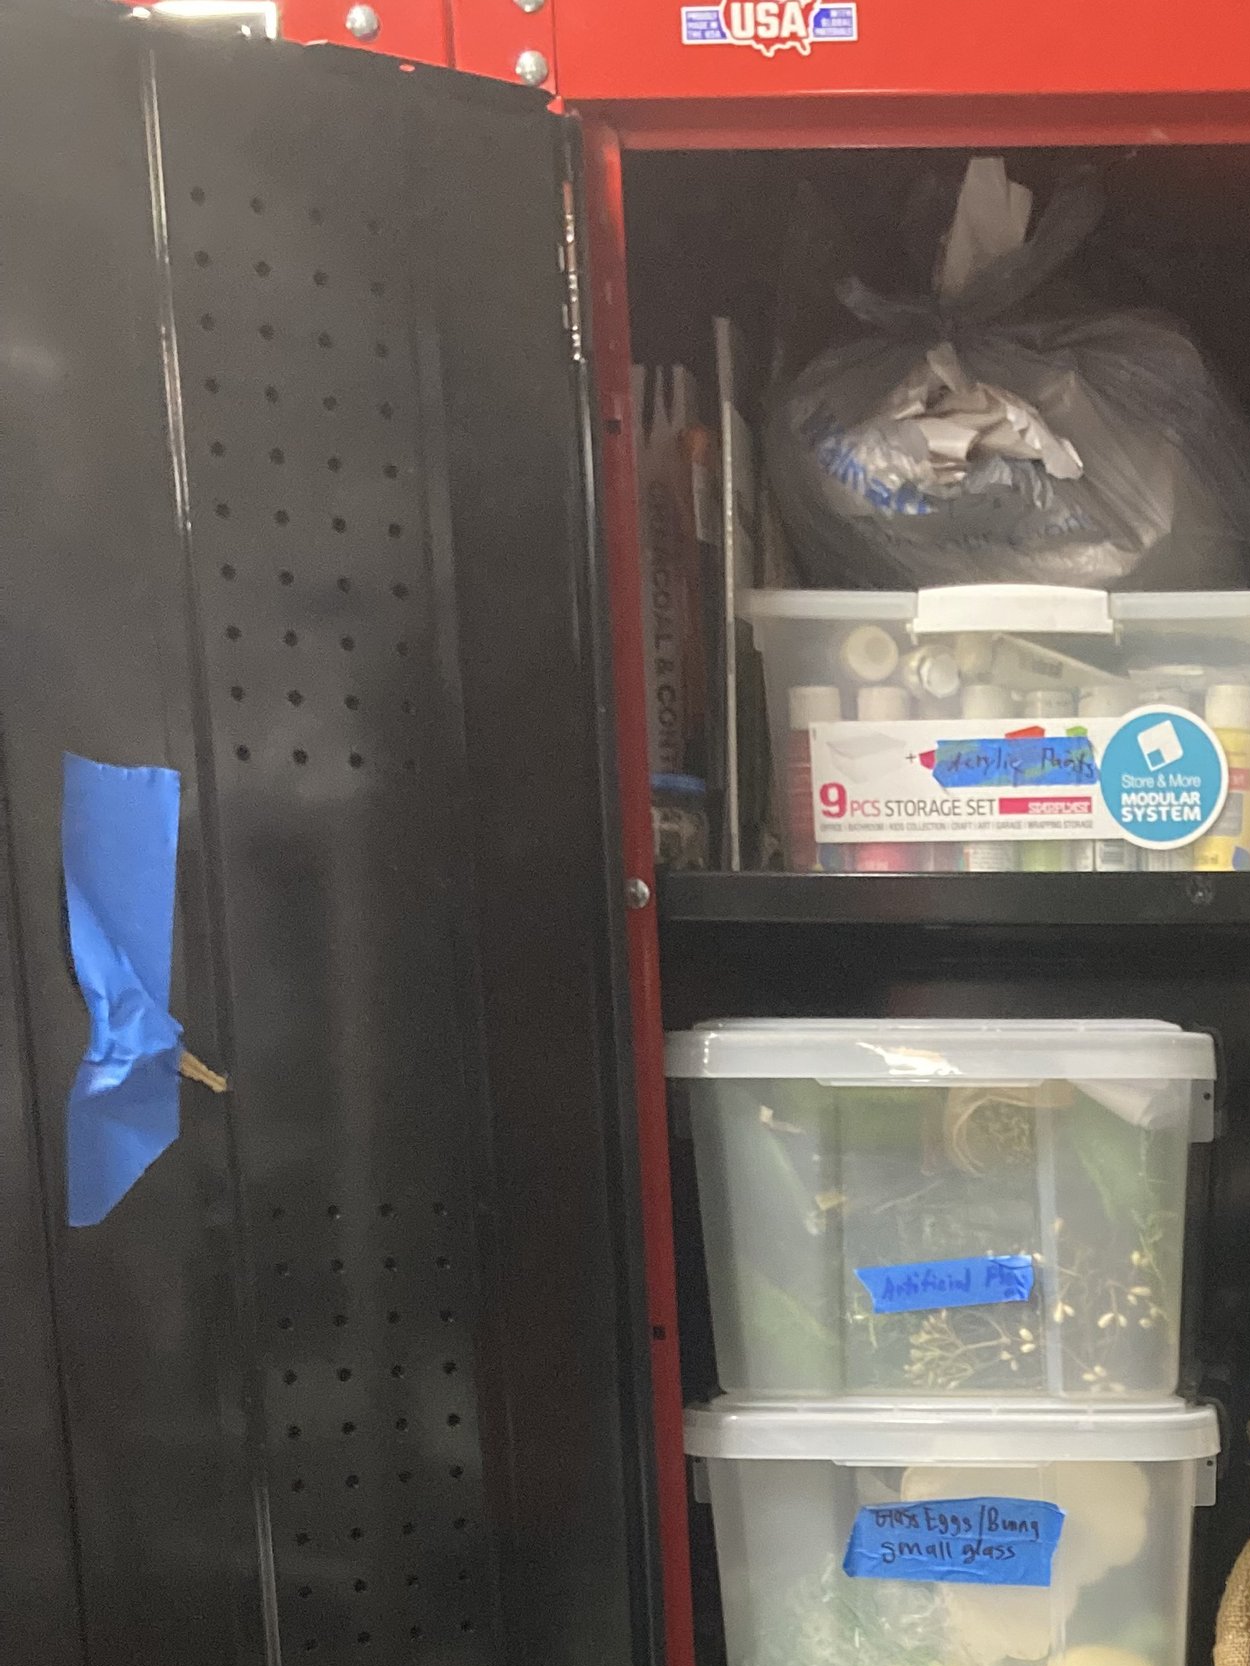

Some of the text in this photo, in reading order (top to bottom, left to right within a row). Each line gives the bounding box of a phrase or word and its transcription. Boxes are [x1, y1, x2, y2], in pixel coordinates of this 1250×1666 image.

[730, 1, 808, 39] USA
[1121, 773, 1202, 789] Store & More
[819, 782, 997, 819] 9 PCS STORAGE SET
[1120, 791, 1201, 806] MODULAR
[1120, 806, 1202, 822] SYSTEM
[962, 1538, 1016, 1565] glass
